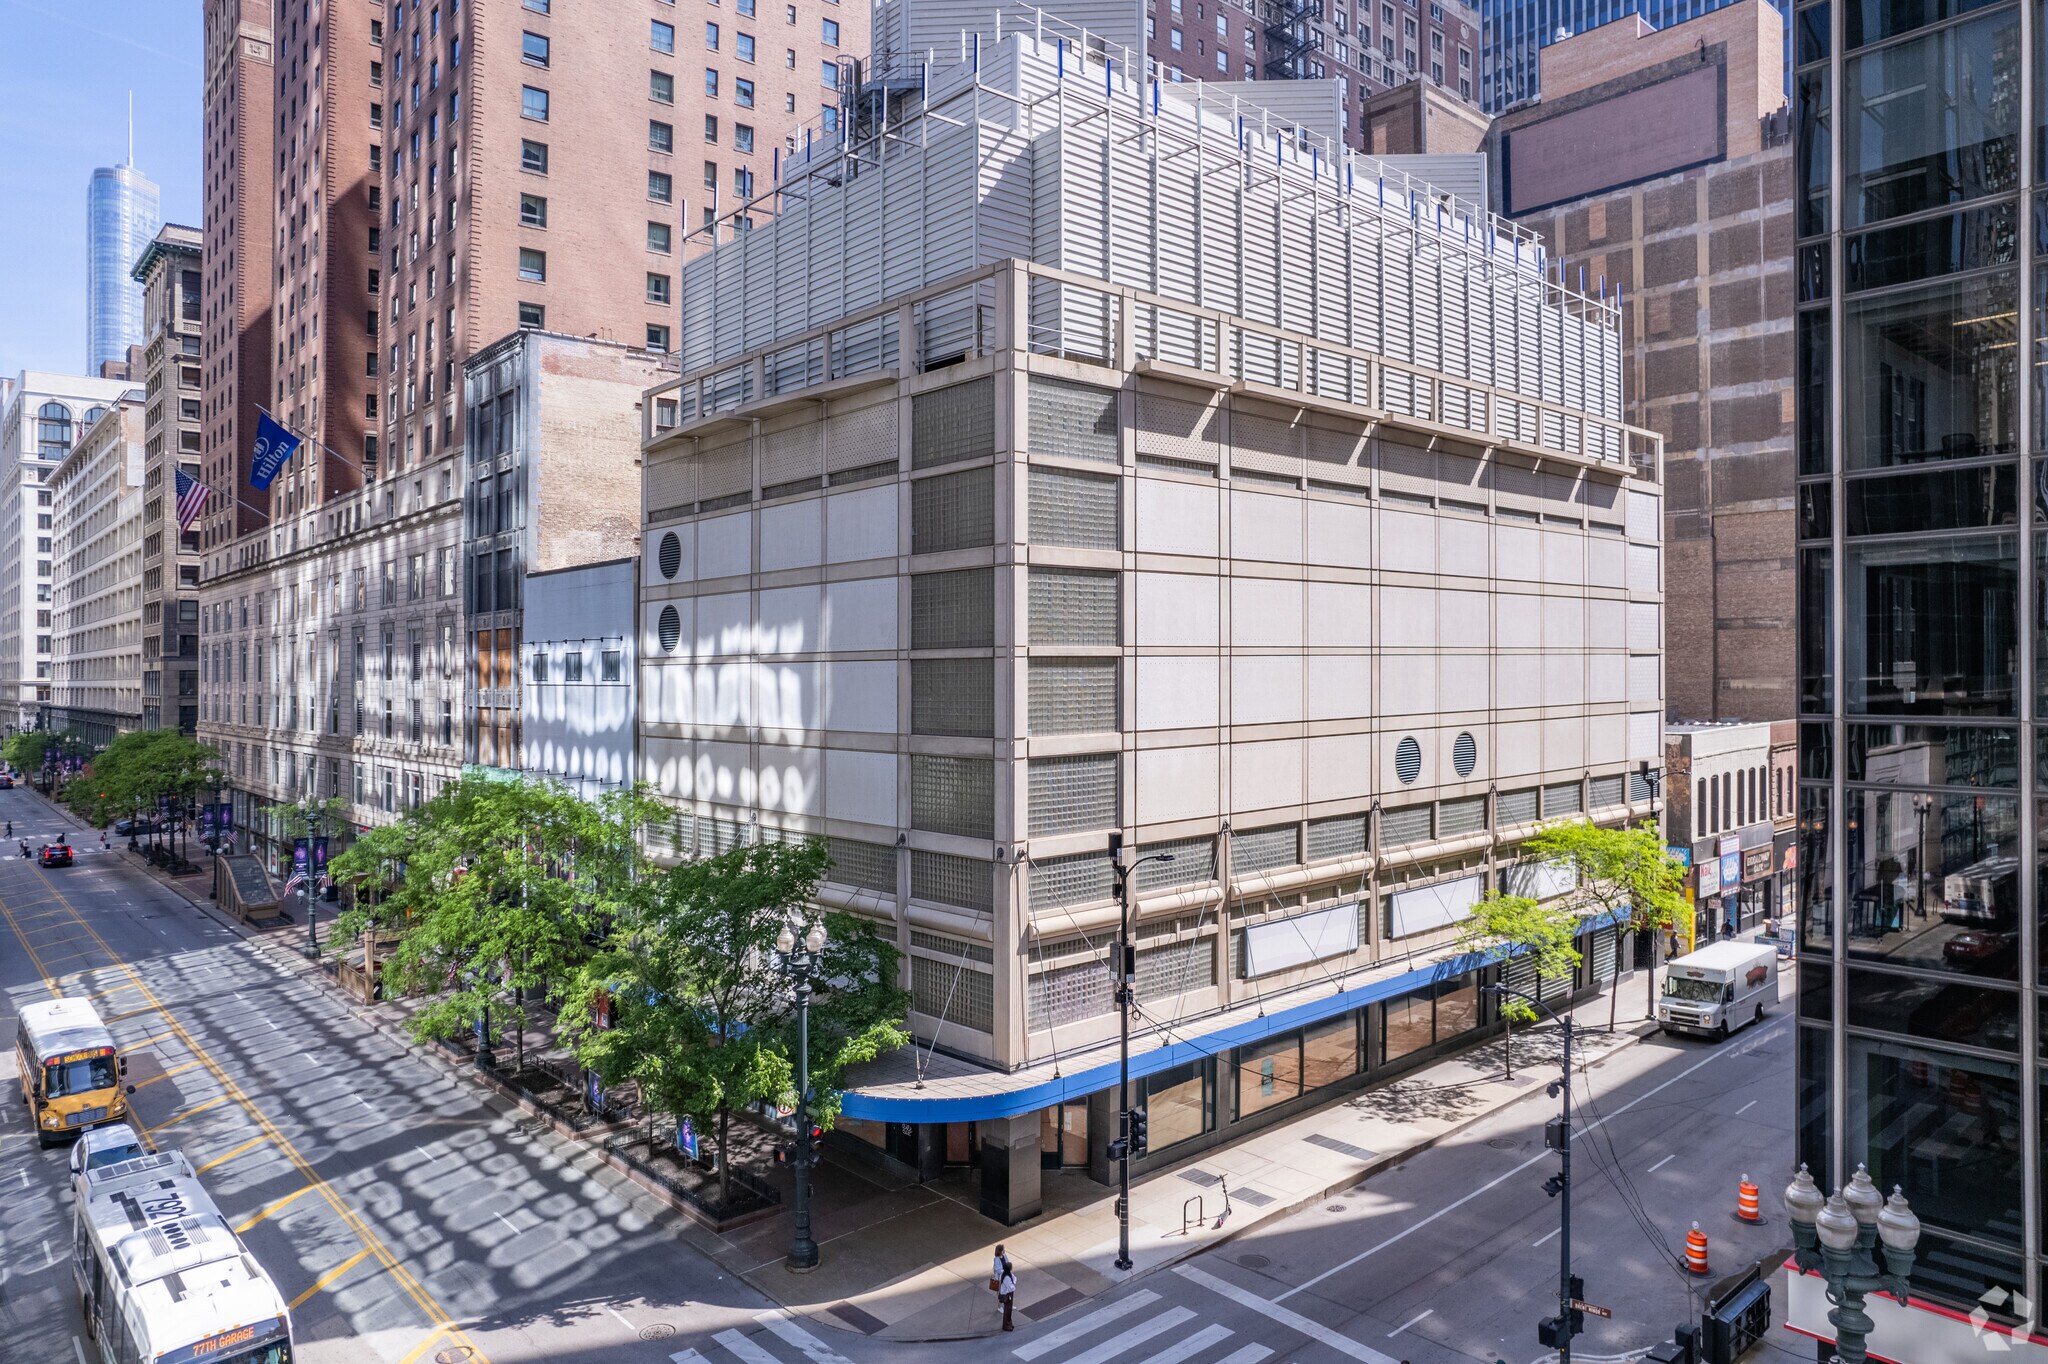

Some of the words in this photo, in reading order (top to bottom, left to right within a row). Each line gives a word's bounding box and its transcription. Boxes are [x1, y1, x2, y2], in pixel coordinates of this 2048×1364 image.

[257, 441, 290, 479] Hilton
[64, 1052, 88, 1064] SCHOOL
[142, 1192, 191, 1226] 7921
[192, 1338, 217, 1357] 77TH
[218, 1326, 255, 1348] GARAGE
